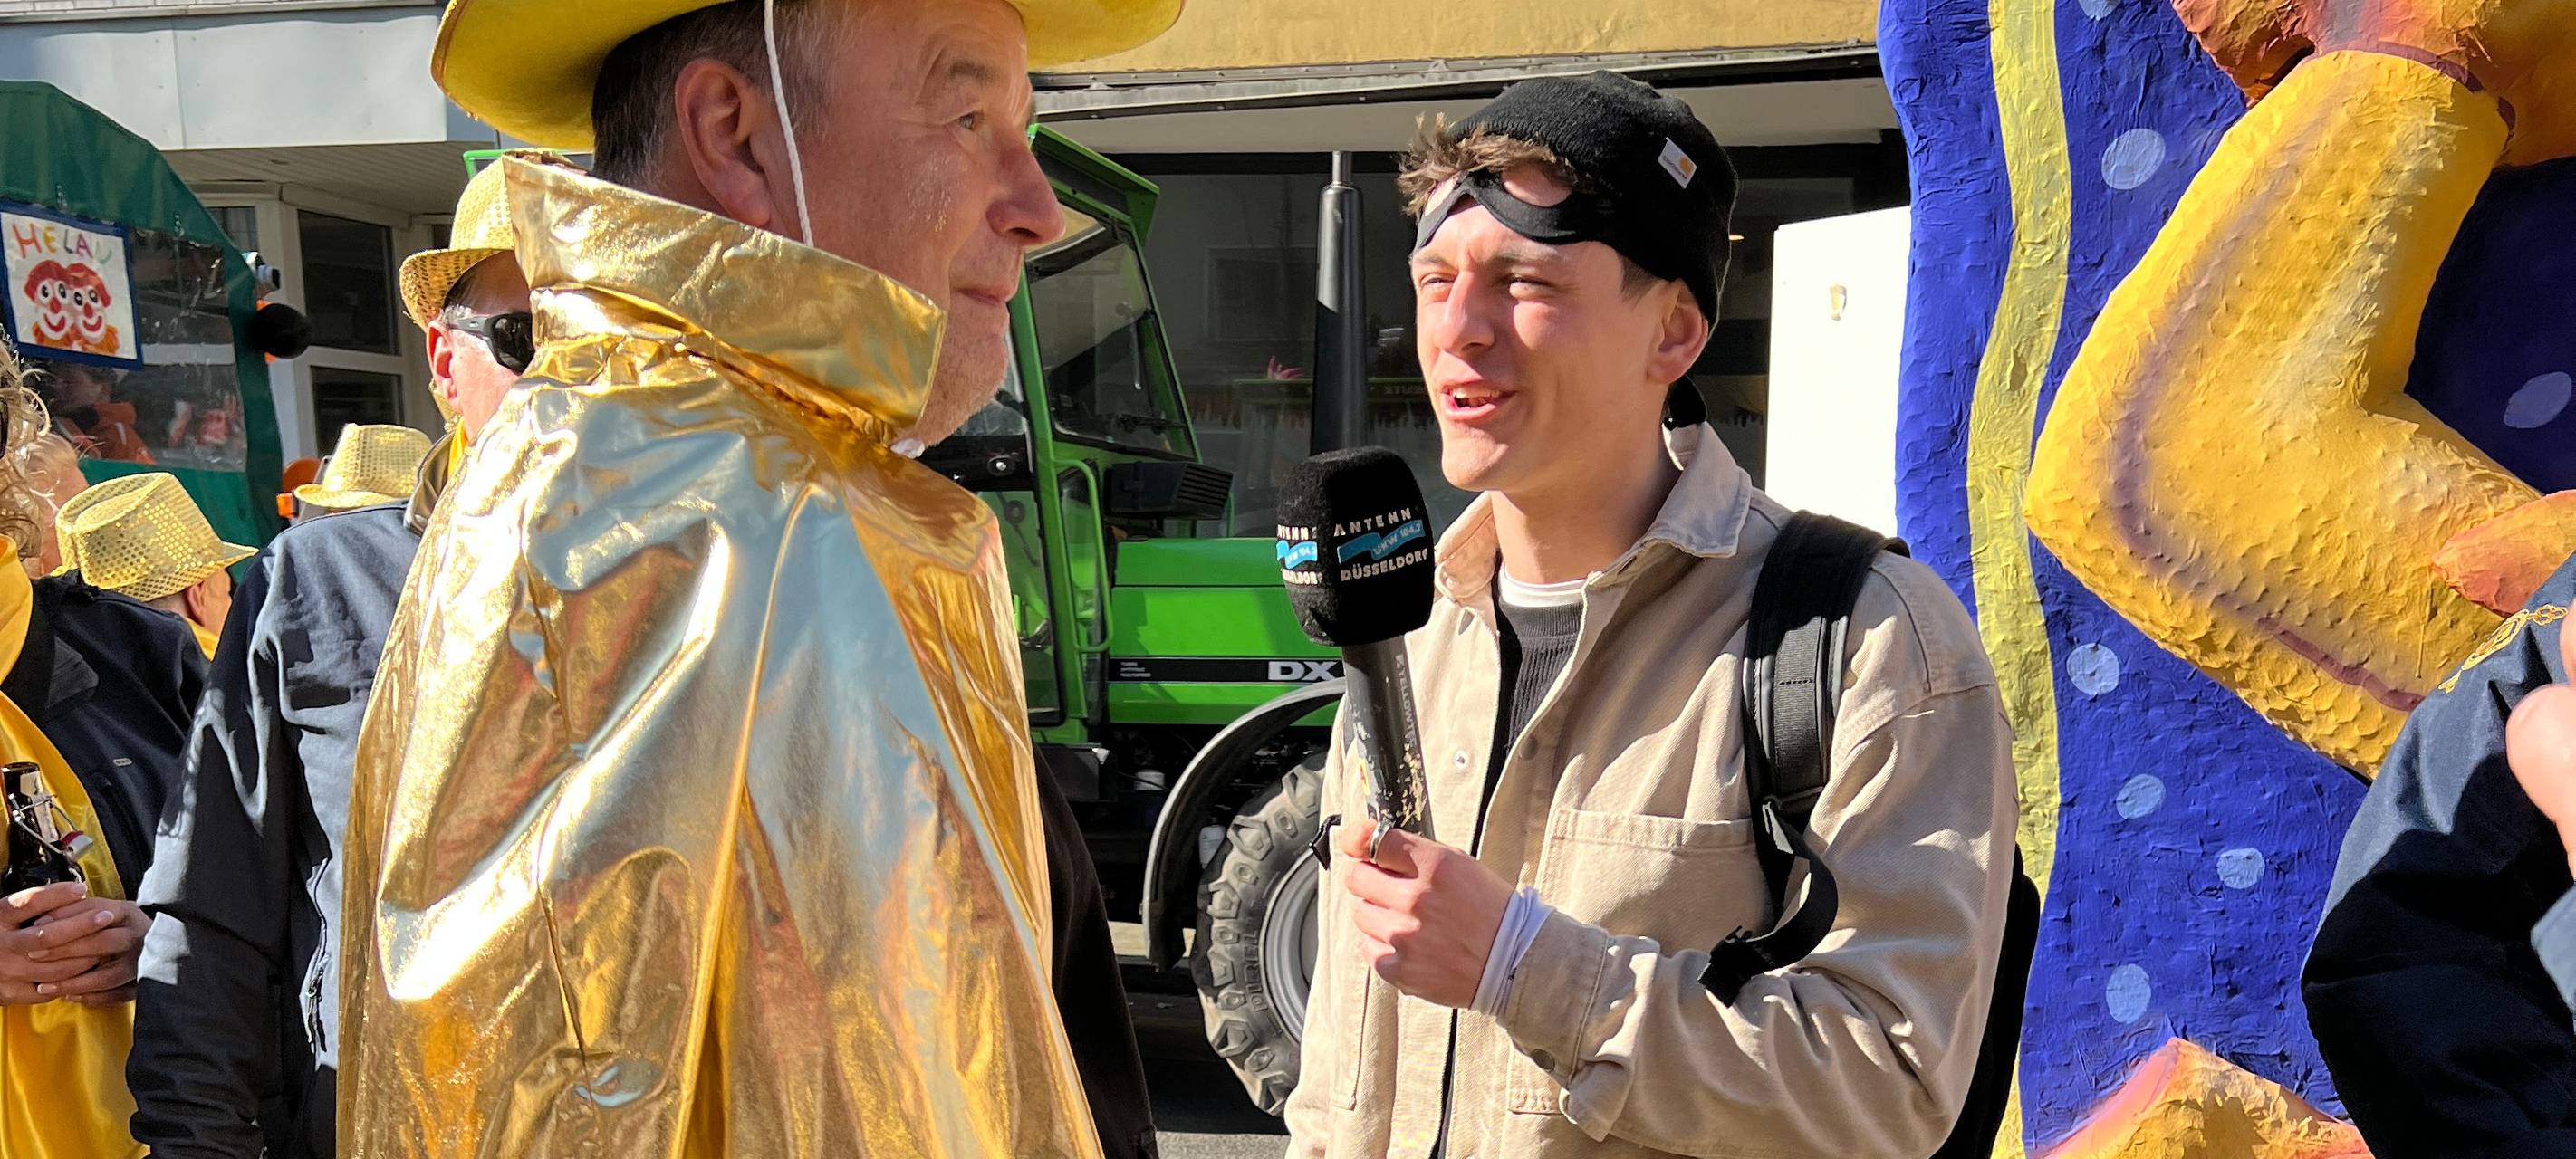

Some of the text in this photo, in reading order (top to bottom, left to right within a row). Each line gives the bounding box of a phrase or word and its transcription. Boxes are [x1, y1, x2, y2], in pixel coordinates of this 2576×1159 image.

[12, 223, 113, 264] HELAU
[1334, 507, 1415, 537] ANTENN
[1341, 548, 1428, 582] DÜSSELDORF
[1268, 661, 1339, 681] DX
[1244, 907, 1268, 1012] PIREL
